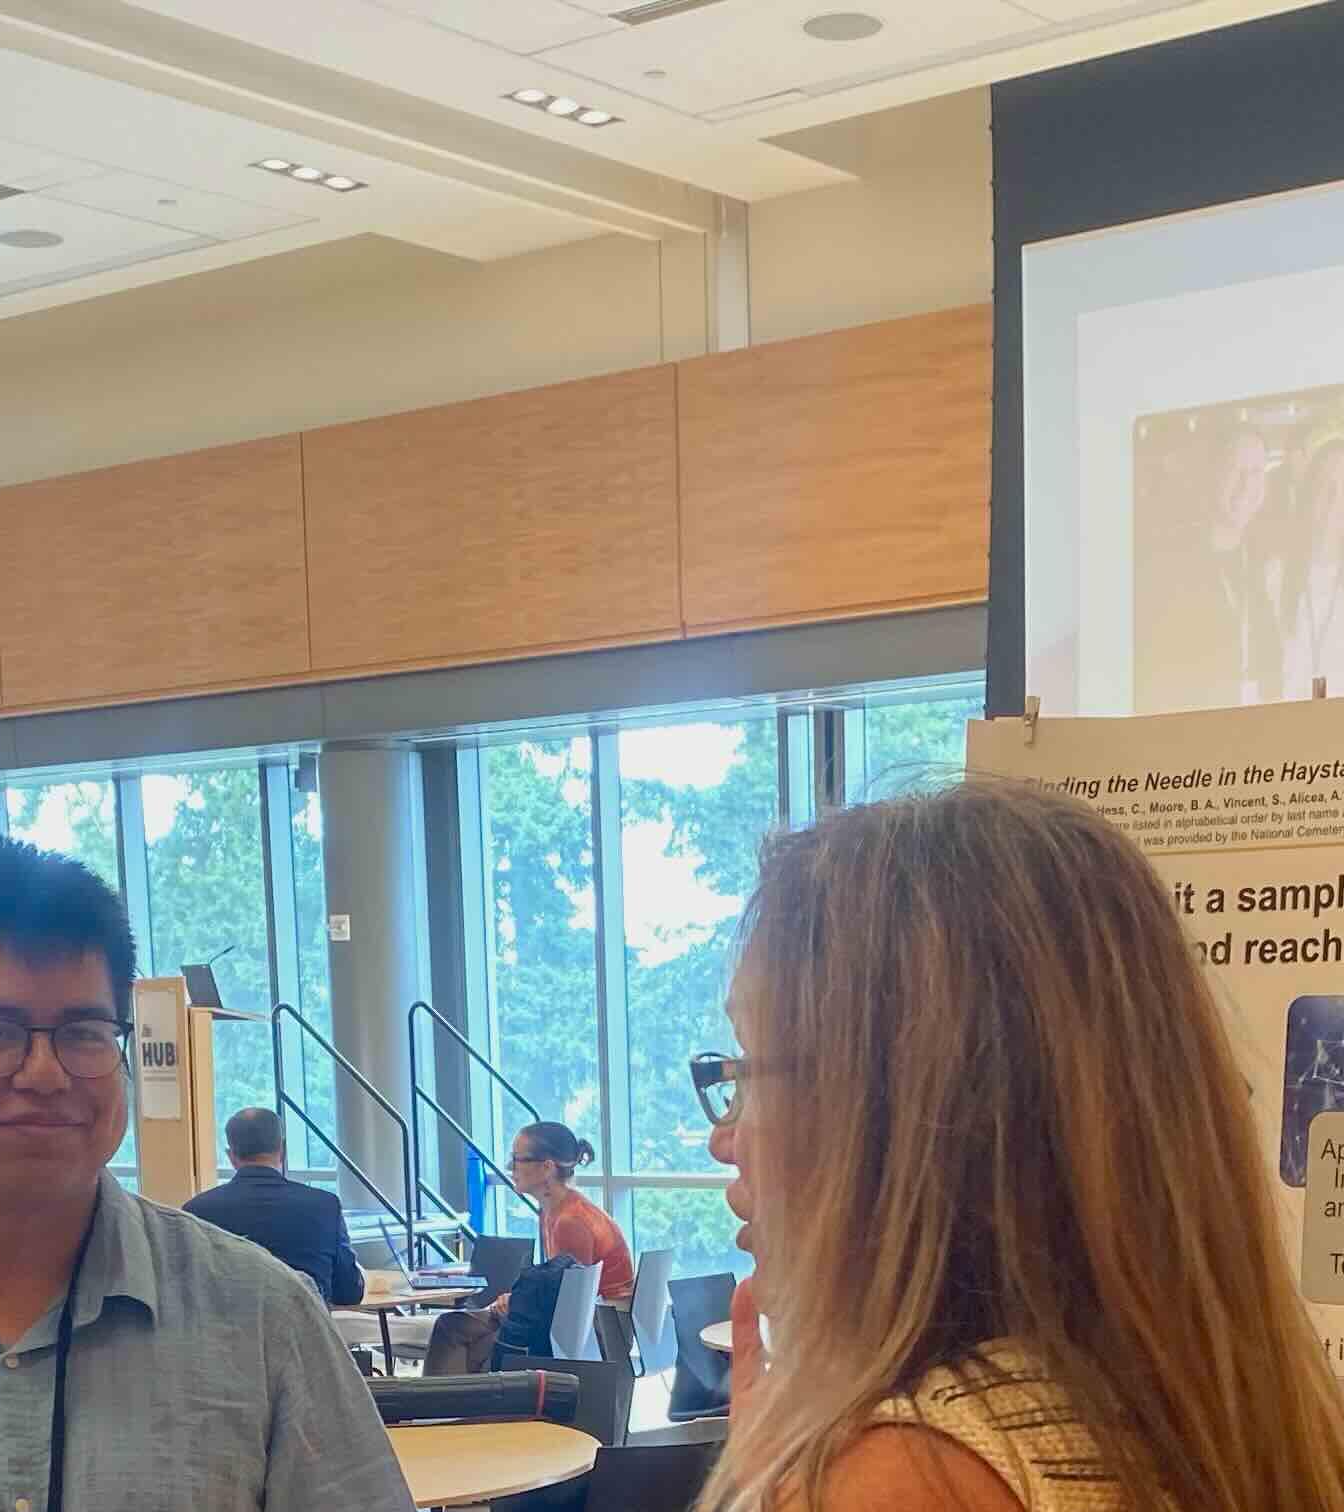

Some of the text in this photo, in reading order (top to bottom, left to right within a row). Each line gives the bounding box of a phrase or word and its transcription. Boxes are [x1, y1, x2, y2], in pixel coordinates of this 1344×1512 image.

[1108, 775, 1138, 793] the
[1145, 769, 1212, 790] Needle
[1218, 768, 1236, 785] in
[1244, 765, 1274, 784] the
[1206, 889, 1224, 913] a
[142, 1042, 175, 1067] HUB
